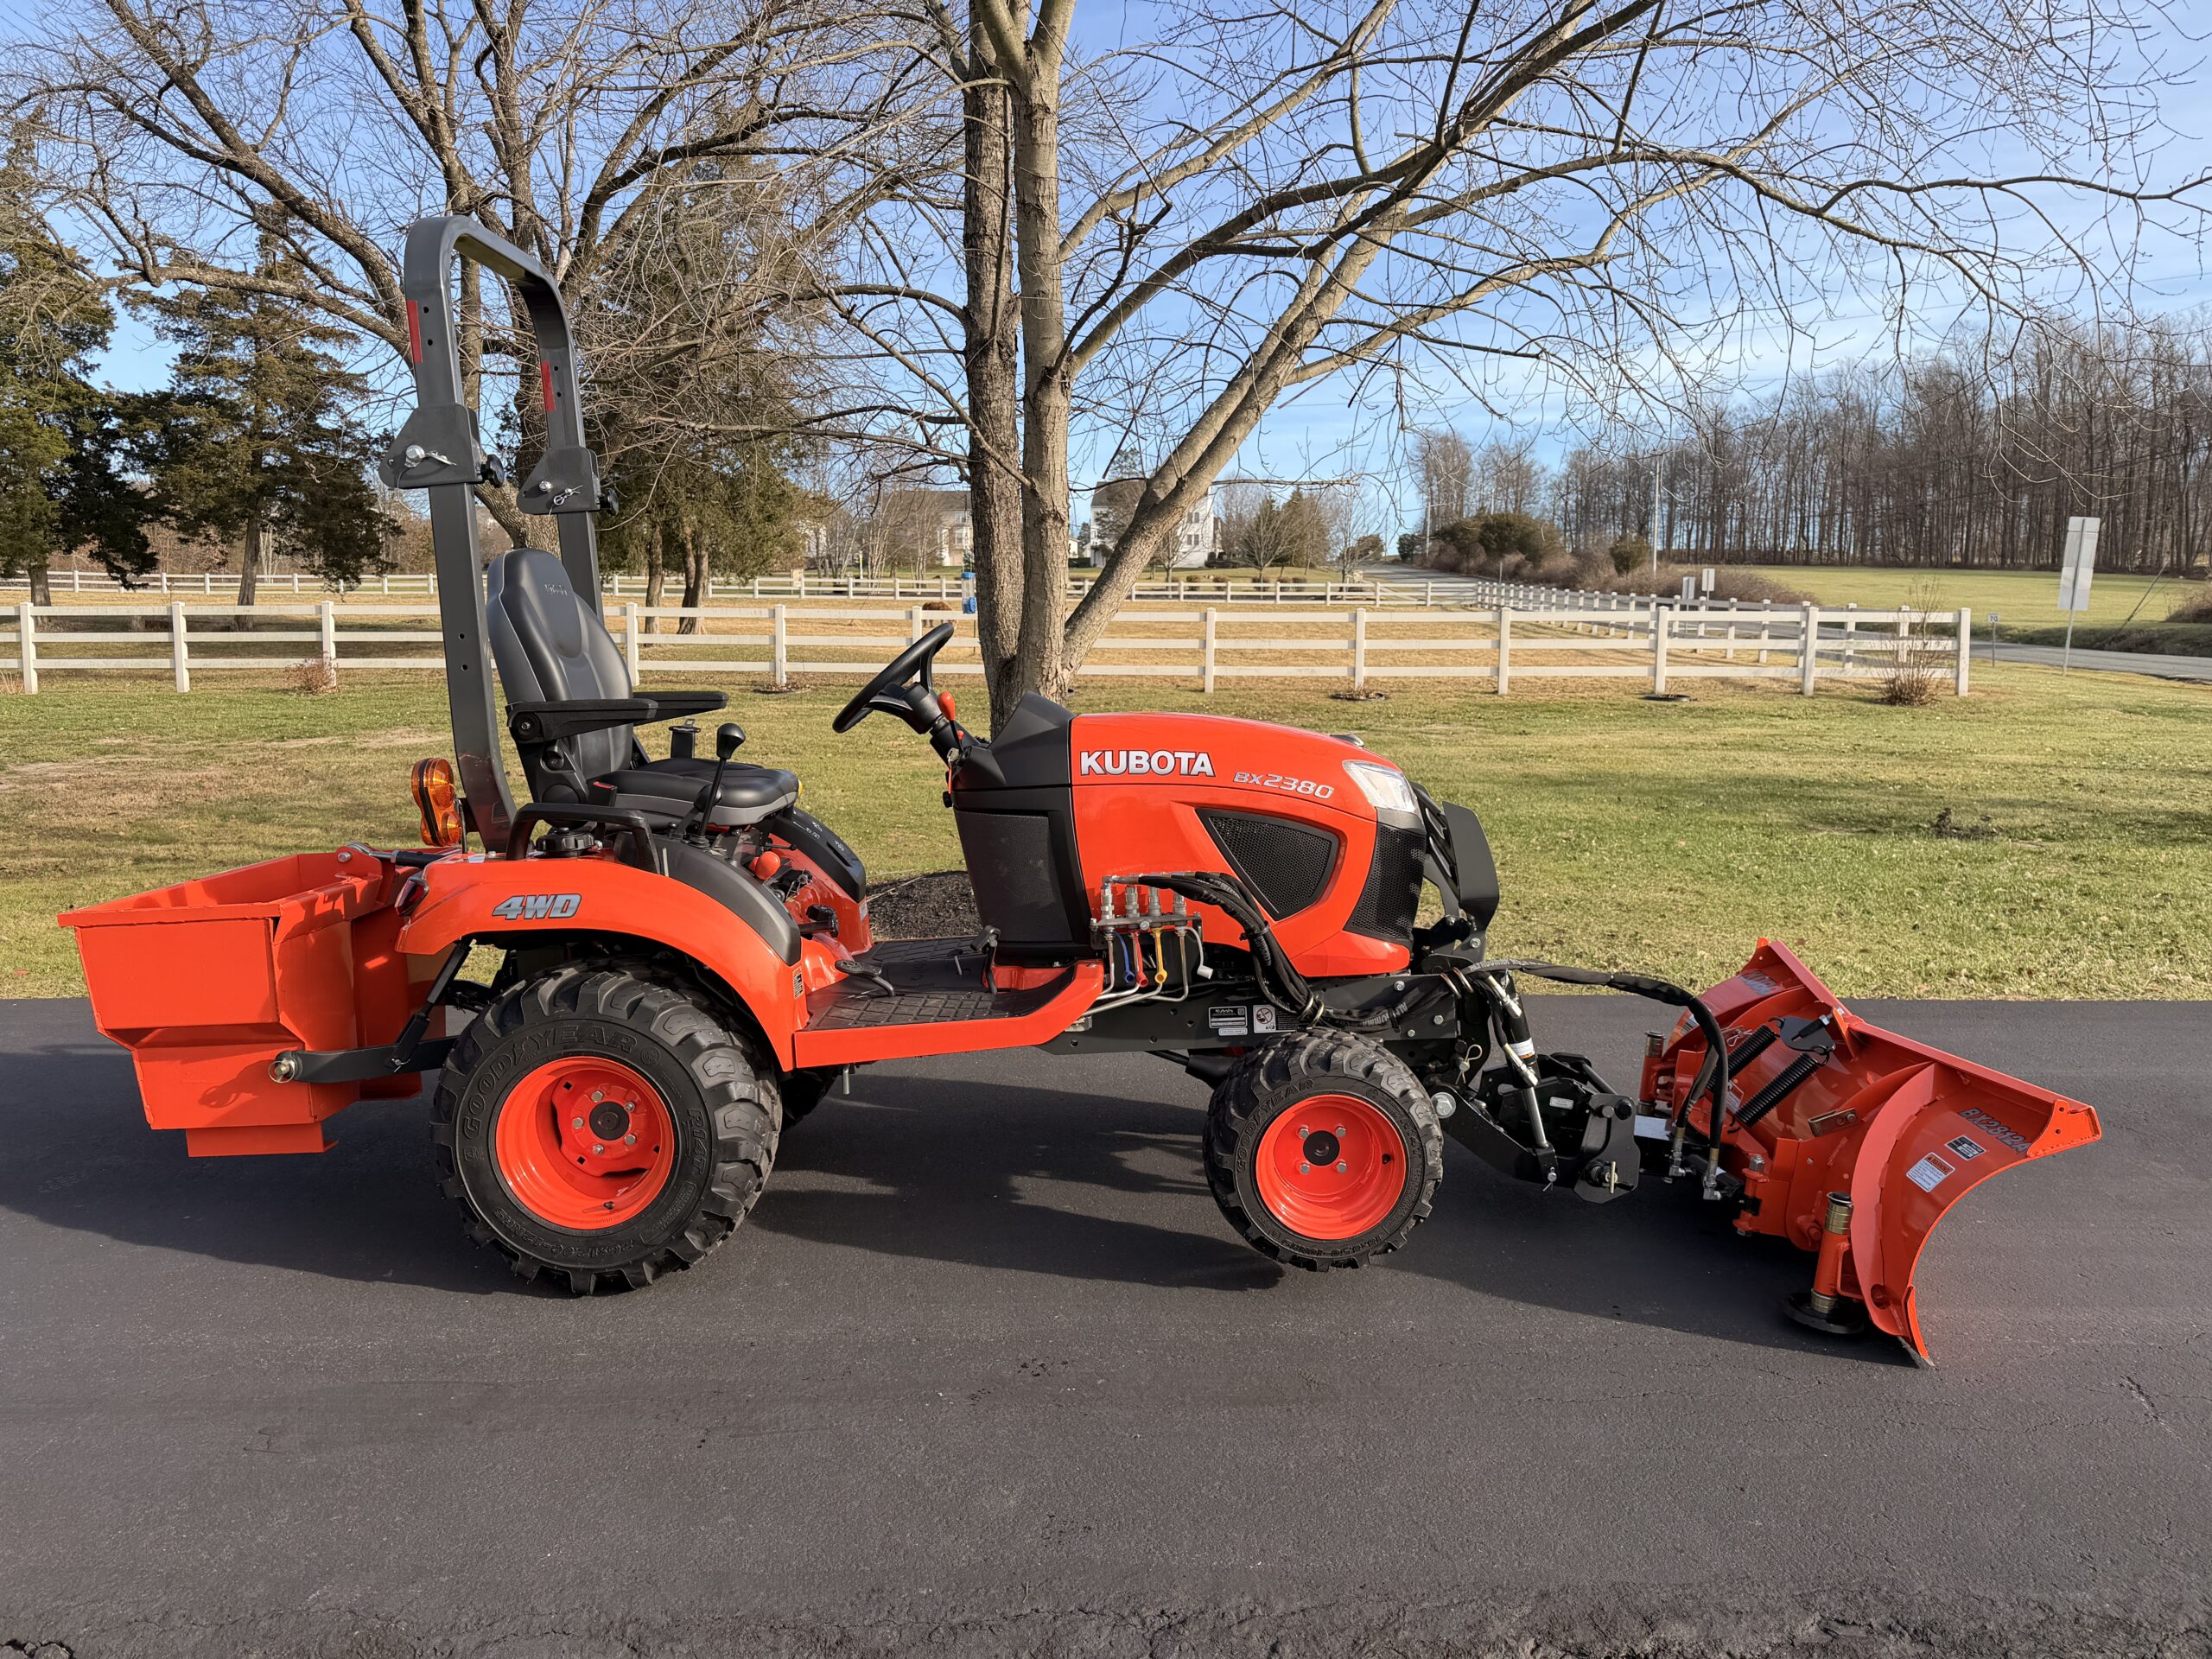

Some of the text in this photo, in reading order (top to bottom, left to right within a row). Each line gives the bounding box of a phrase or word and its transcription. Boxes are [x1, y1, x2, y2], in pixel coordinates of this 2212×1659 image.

[1080, 750, 1215, 778] KUBOTA
[1233, 772, 1335, 799] BX2380
[492, 893, 582, 920] 4WD
[463, 1026, 638, 1139] GOODYEAR
[688, 1109, 707, 1175] R14T
[1236, 1079, 1314, 1173] GOODYEAR
